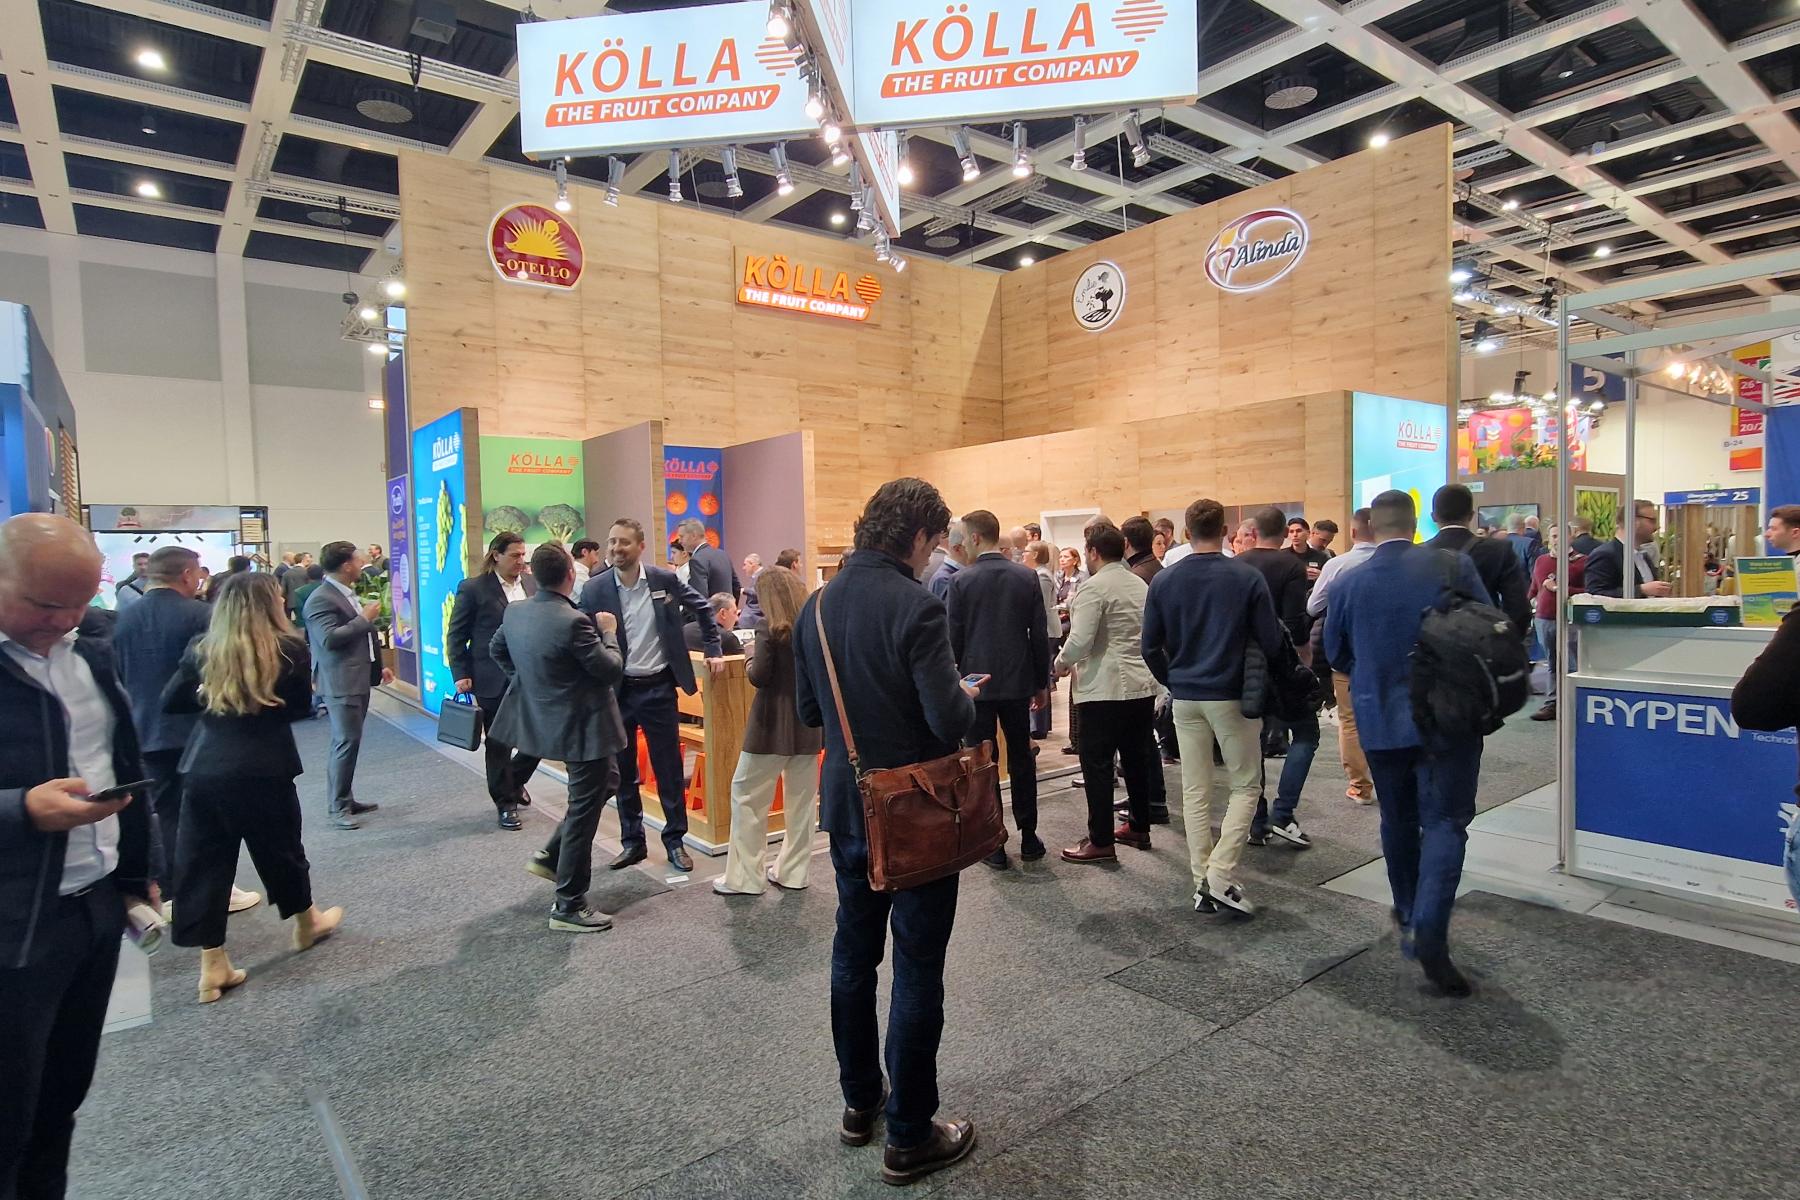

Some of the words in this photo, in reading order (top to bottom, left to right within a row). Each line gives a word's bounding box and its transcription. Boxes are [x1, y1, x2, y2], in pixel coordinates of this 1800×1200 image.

[891, 2, 1096, 66] KÖLLA
[554, 37, 741, 97] KÖLLA
[892, 73, 934, 93] THE
[940, 67, 1009, 89] FRUIT
[1013, 55, 1131, 81] COMPANY
[555, 104, 594, 123] THE
[600, 98, 662, 119] FRUIT
[666, 89, 773, 113] COMPANY
[1231, 231, 1301, 269] Alinda
[506, 258, 571, 280] OTELLO
[743, 254, 850, 302] KÖLLA
[745, 288, 769, 303] THE
[771, 292, 808, 309] FRUIT
[809, 299, 866, 319] COMPANY
[1398, 419, 1432, 441] KÖLLA
[510, 451, 563, 467] KÖLLA
[1732, 490, 1750, 501] 25
[1752, 732, 1798, 745] Technol
